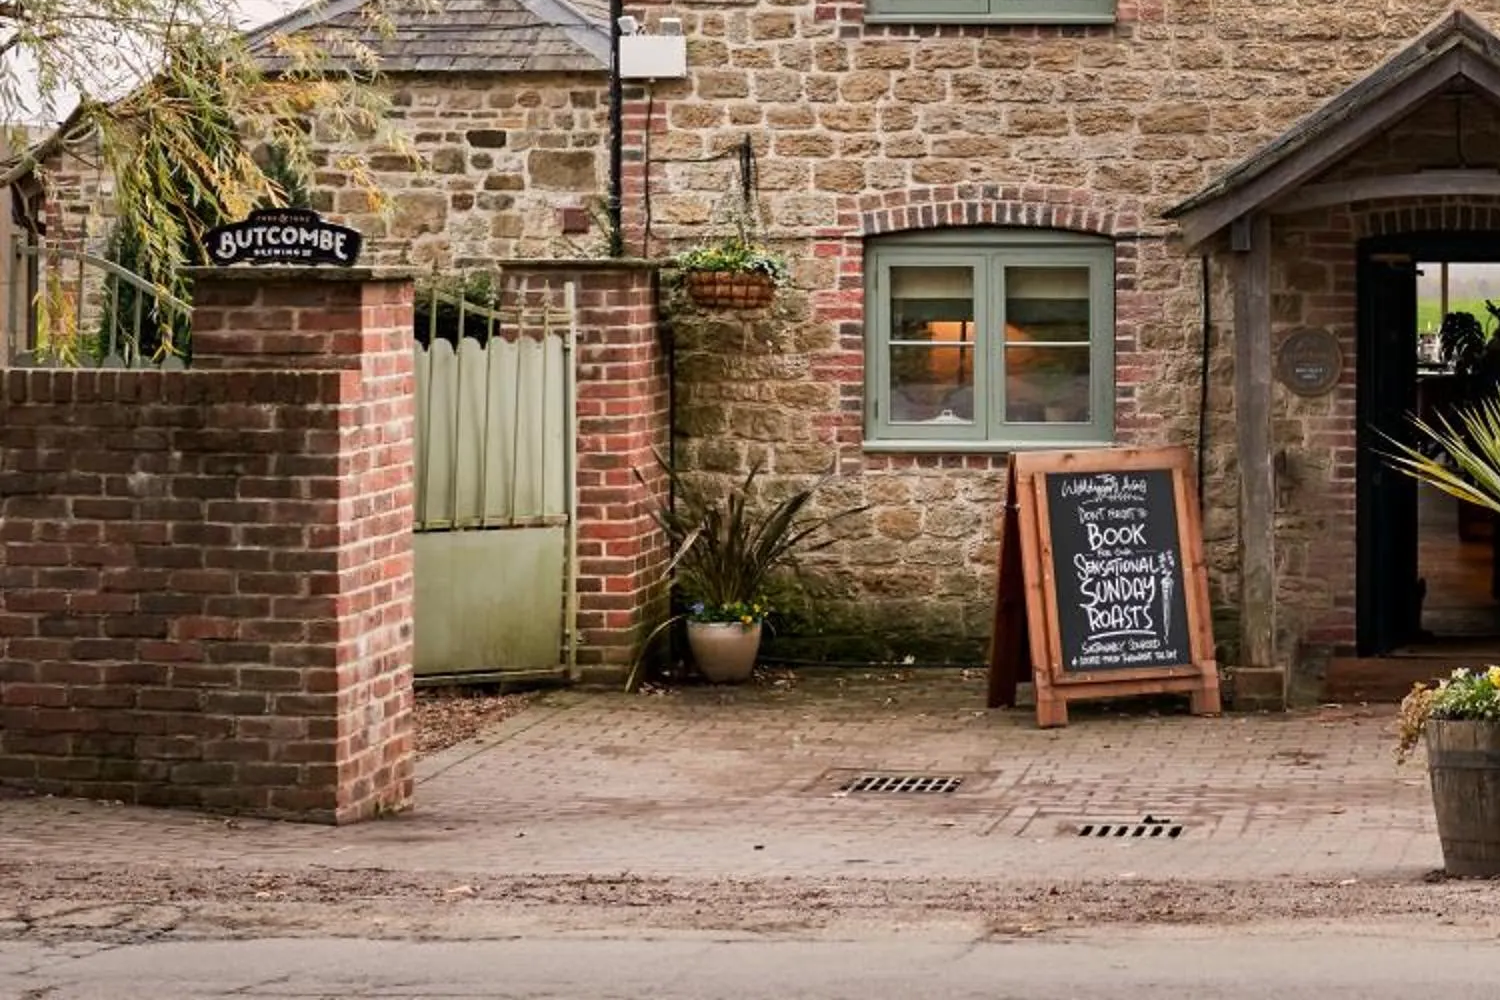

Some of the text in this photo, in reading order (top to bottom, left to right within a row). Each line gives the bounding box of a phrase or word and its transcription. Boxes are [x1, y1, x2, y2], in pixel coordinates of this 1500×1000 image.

[215, 226, 348, 260] BUTCOMBE
[1085, 522, 1148, 551] BOOK
[1073, 552, 1160, 581] SENSATIONAL
[1079, 575, 1155, 607] SUNDAY
[1085, 603, 1154, 632] ROASTS
